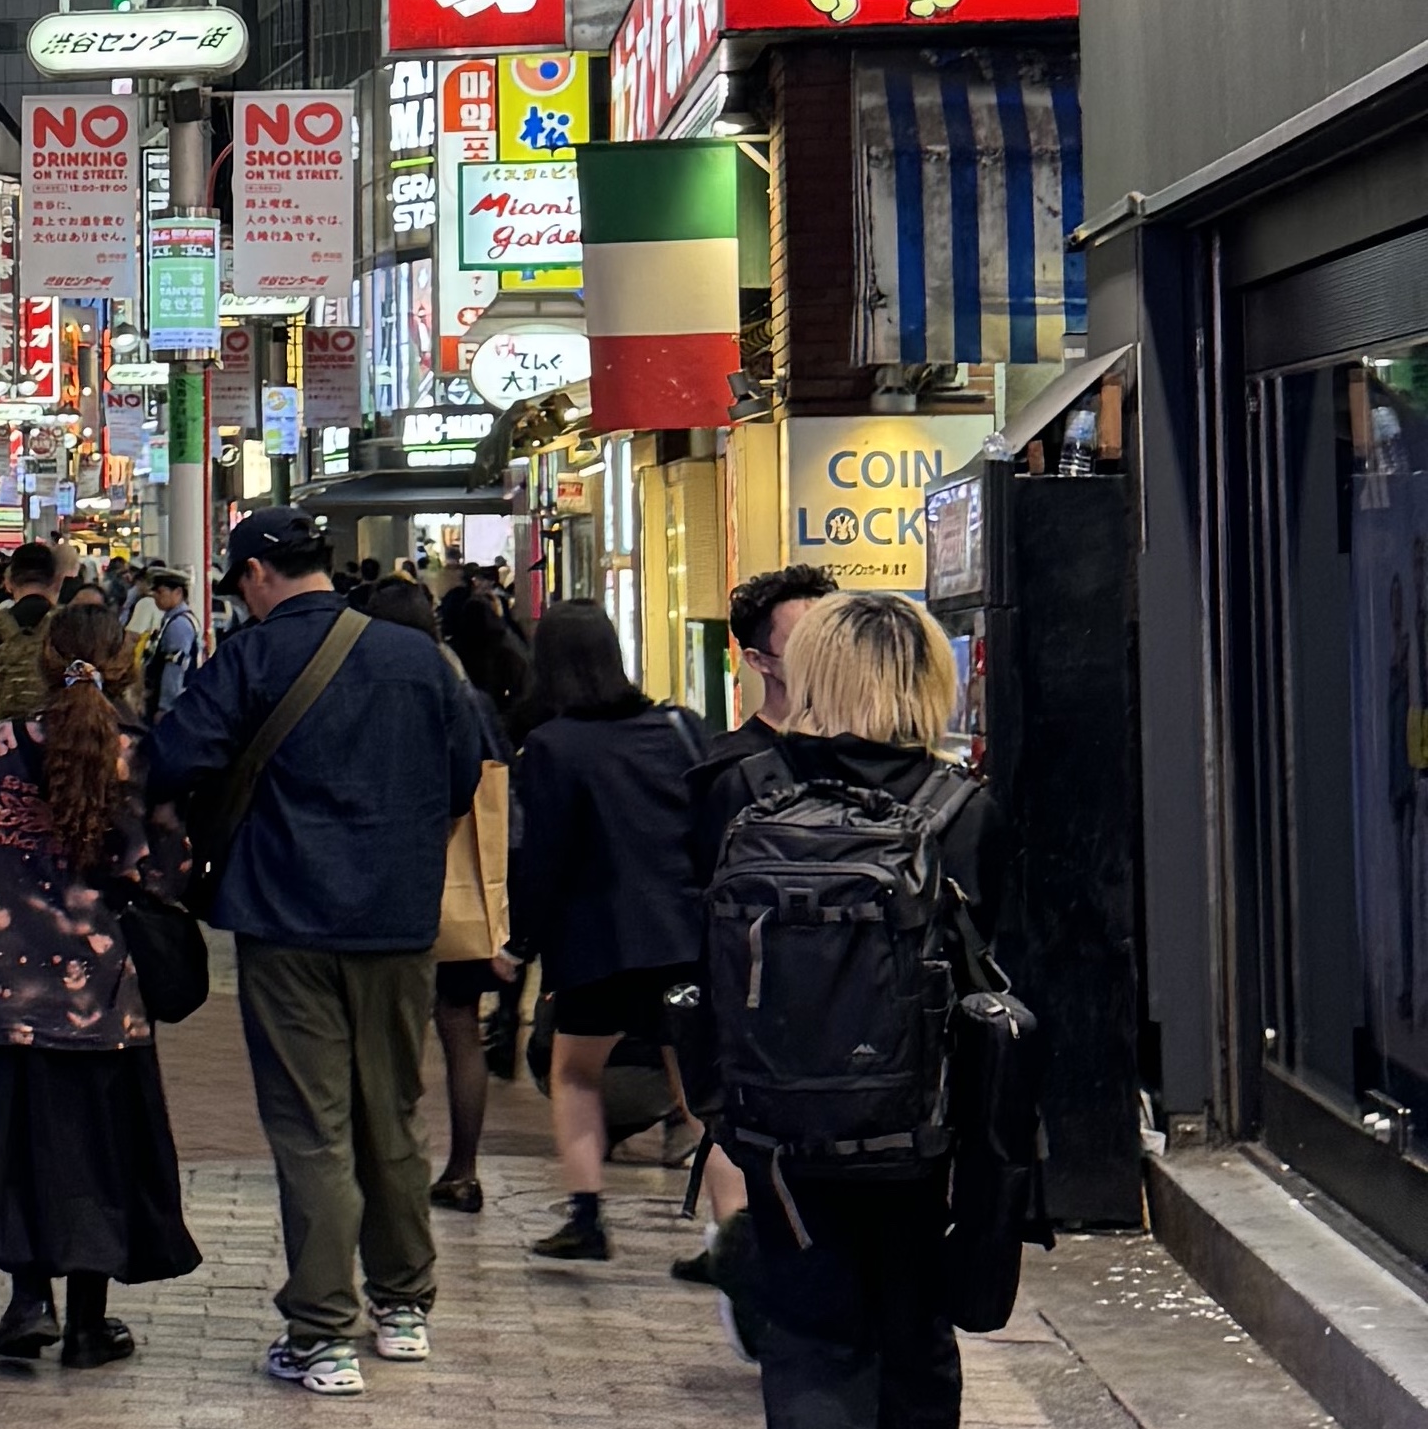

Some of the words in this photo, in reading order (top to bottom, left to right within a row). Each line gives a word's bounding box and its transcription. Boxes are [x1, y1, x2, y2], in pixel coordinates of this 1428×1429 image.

[42, 25, 233, 55] 渋谷センター街
[32, 104, 129, 149] NO
[245, 102, 343, 146] NO
[32, 151, 128, 167] DRINKING
[245, 150, 342, 166] SMOKING
[57, 170, 79, 180] THE
[267, 170, 291, 180] THE
[469, 193, 580, 217] Miami
[308, 330, 355, 353] NO
[828, 449, 943, 489] COIN
[798, 508, 924, 546] LOCK
